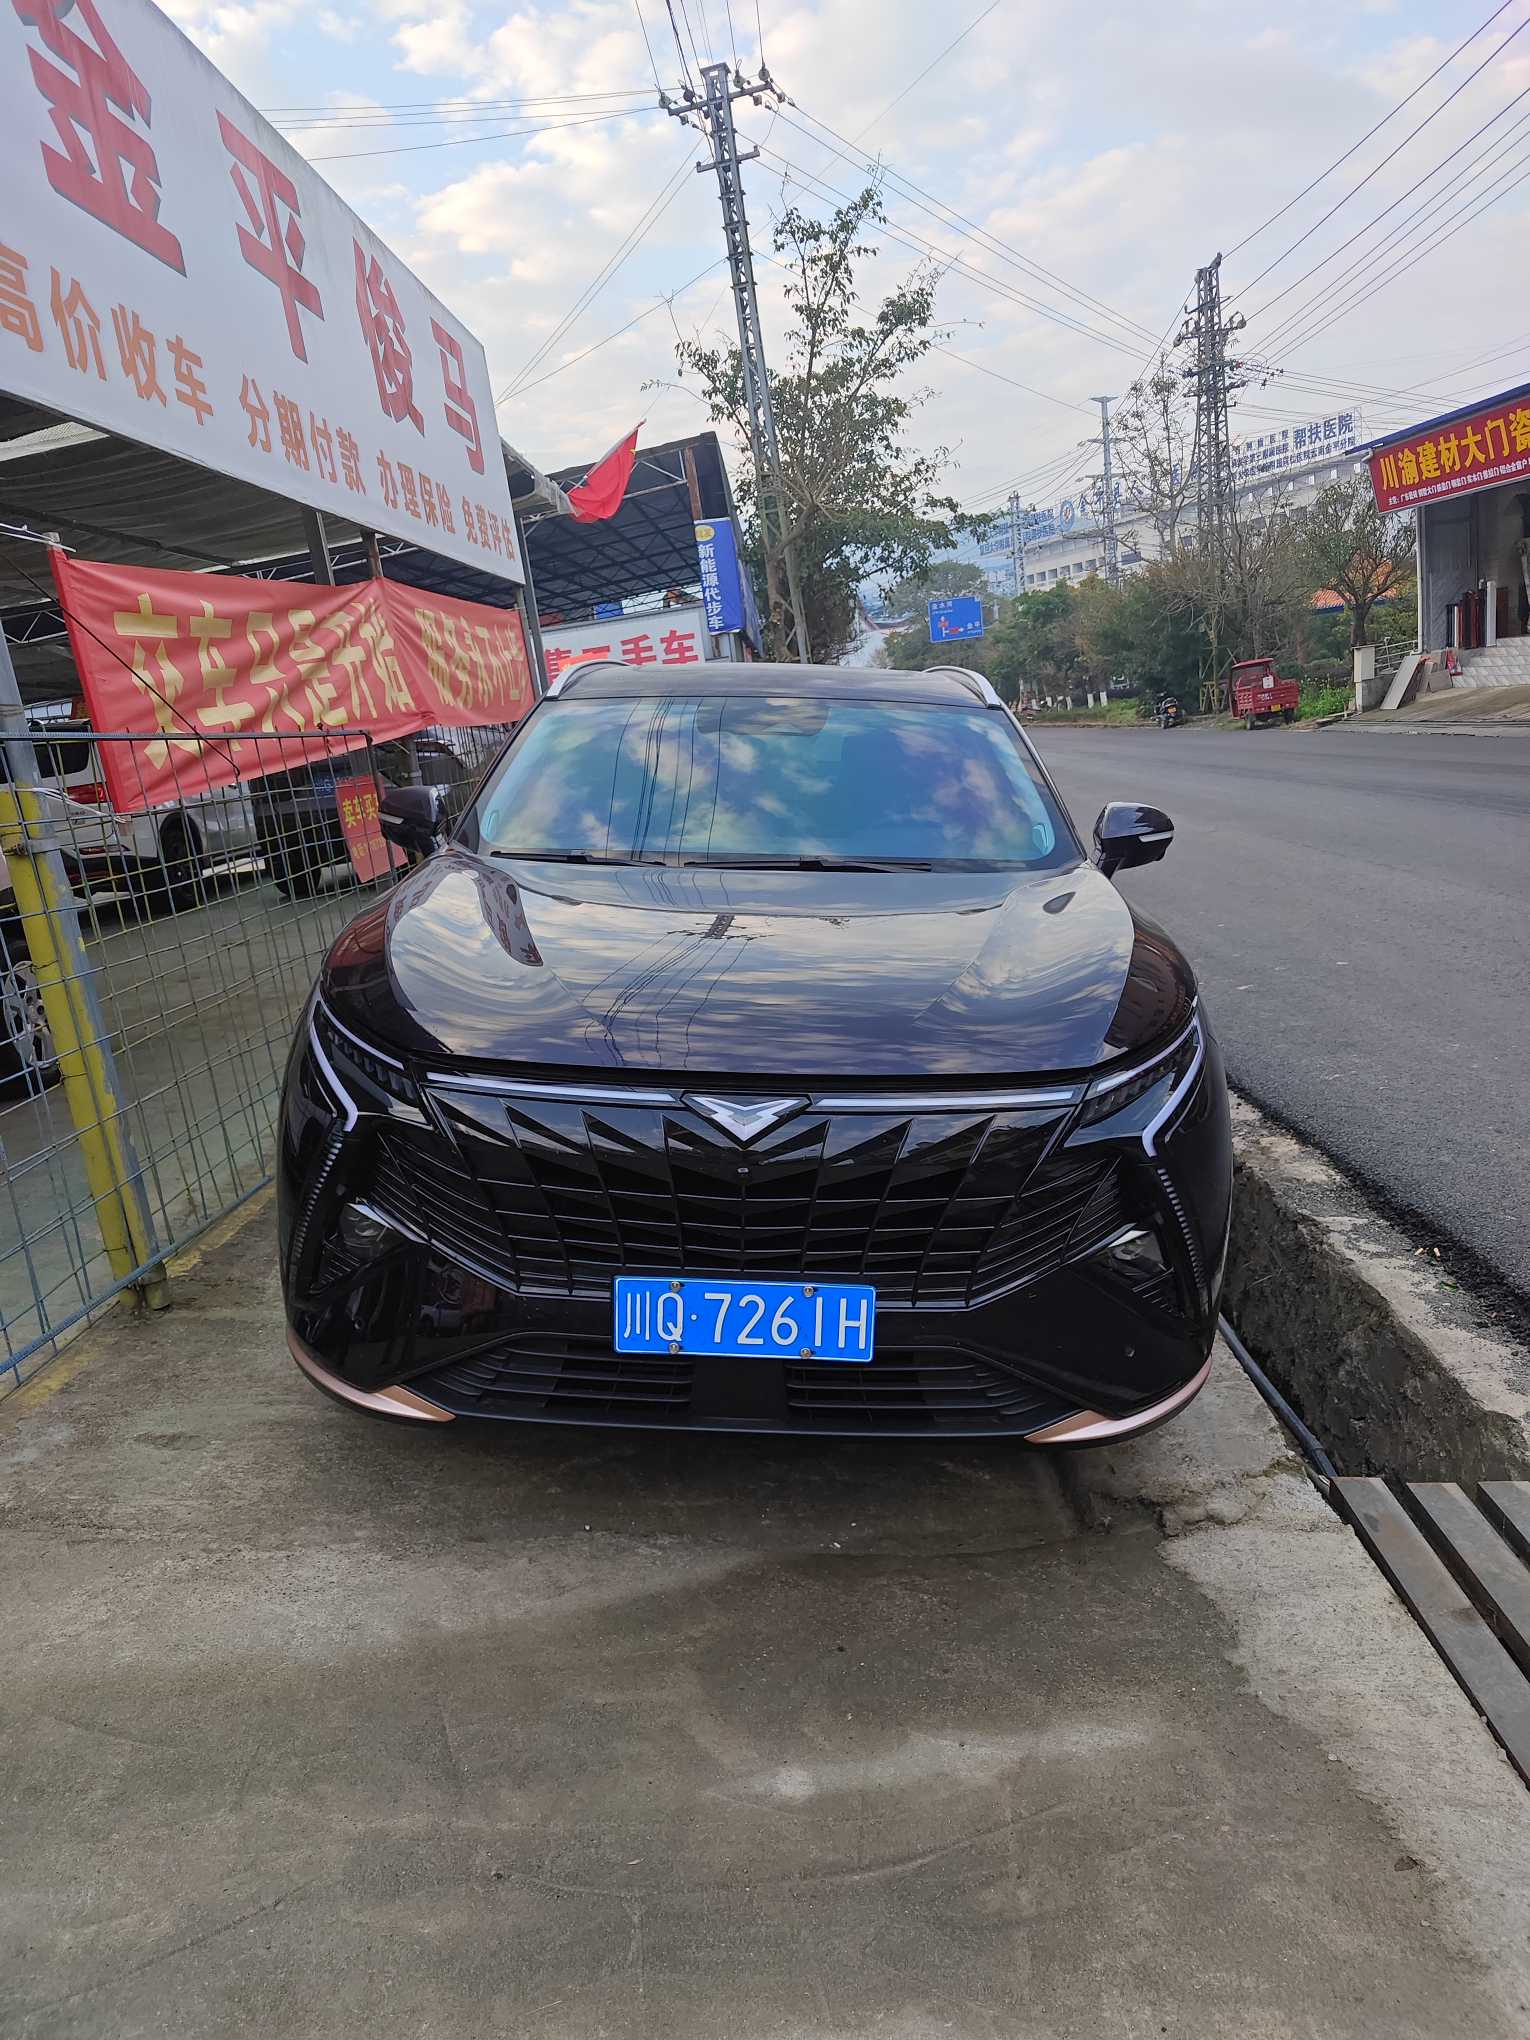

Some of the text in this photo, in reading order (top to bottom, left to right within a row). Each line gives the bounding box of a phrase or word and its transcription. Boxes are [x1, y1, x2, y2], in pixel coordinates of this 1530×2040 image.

[0, 240, 516, 561] 高价收车 分期付款 办理保险 免费评估
[1293, 412, 1355, 450] 帮扶医院
[1380, 407, 1530, 491] 川渝建材大门瓷
[697, 543, 724, 630] 新能源代步车
